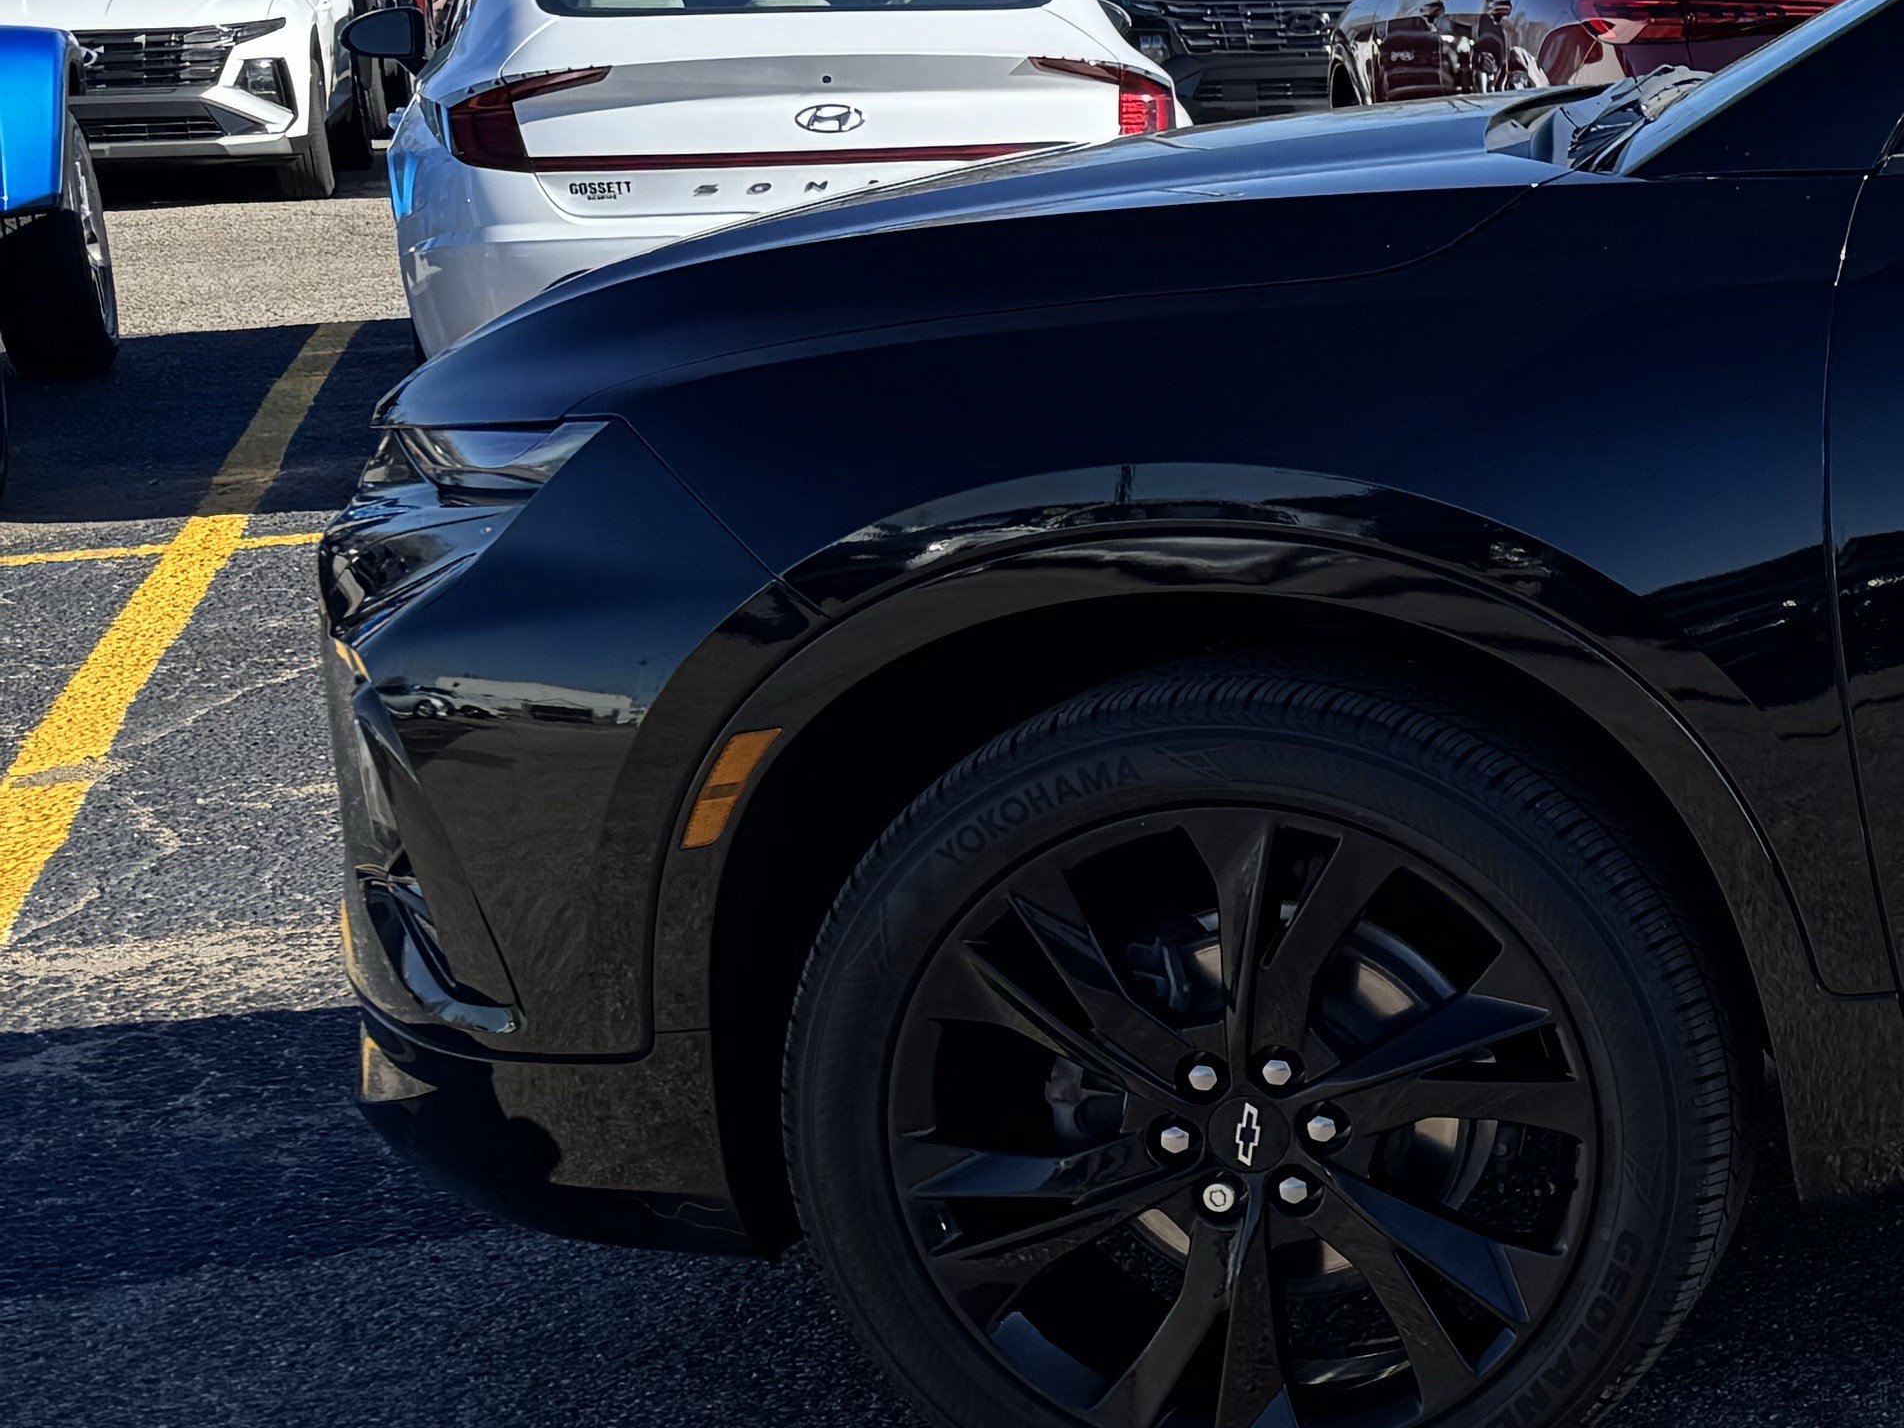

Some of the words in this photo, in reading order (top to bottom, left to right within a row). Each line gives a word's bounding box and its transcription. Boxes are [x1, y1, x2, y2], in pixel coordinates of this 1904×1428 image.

[568, 180, 632, 195] GOSSETT
[691, 179, 879, 197] SON
[934, 755, 1143, 865] YOKOHAMA
